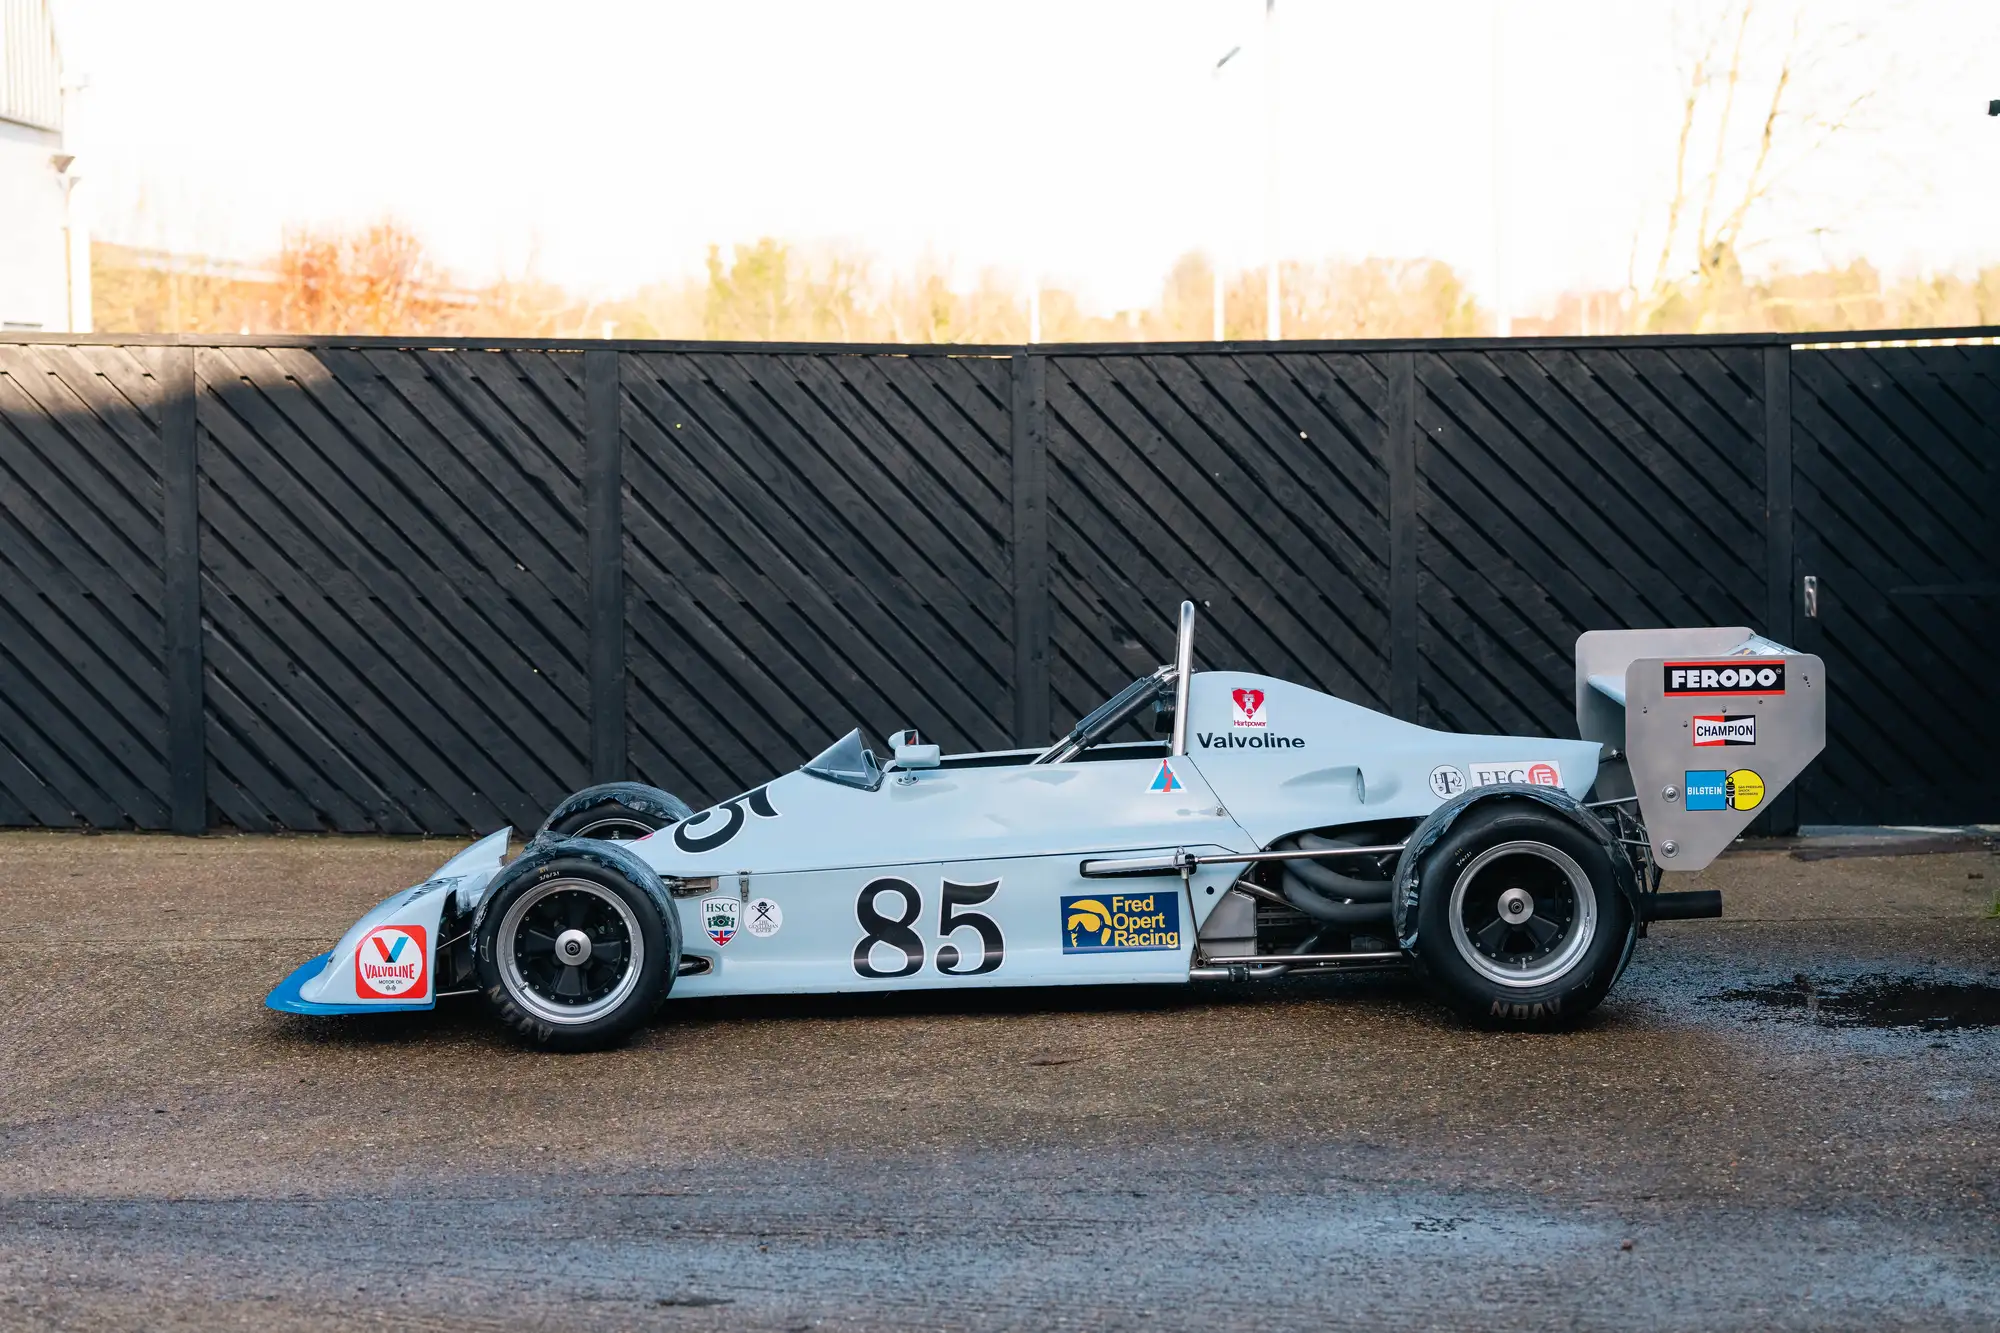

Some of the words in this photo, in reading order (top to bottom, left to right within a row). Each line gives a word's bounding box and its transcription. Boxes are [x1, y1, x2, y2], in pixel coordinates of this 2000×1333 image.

[1671, 668, 1777, 689] FERODO
[1696, 725, 1753, 737] CHAMPION
[1196, 732, 1305, 748] Valvoline
[1687, 786, 1723, 795] BILSTEIN
[706, 903, 737, 912] HSCC
[1112, 895, 1154, 913] Fred
[852, 876, 1005, 979] 85
[1113, 912, 1165, 933] Opert
[1114, 929, 1179, 948] Racing
[364, 963, 415, 980] VALVOLINE
